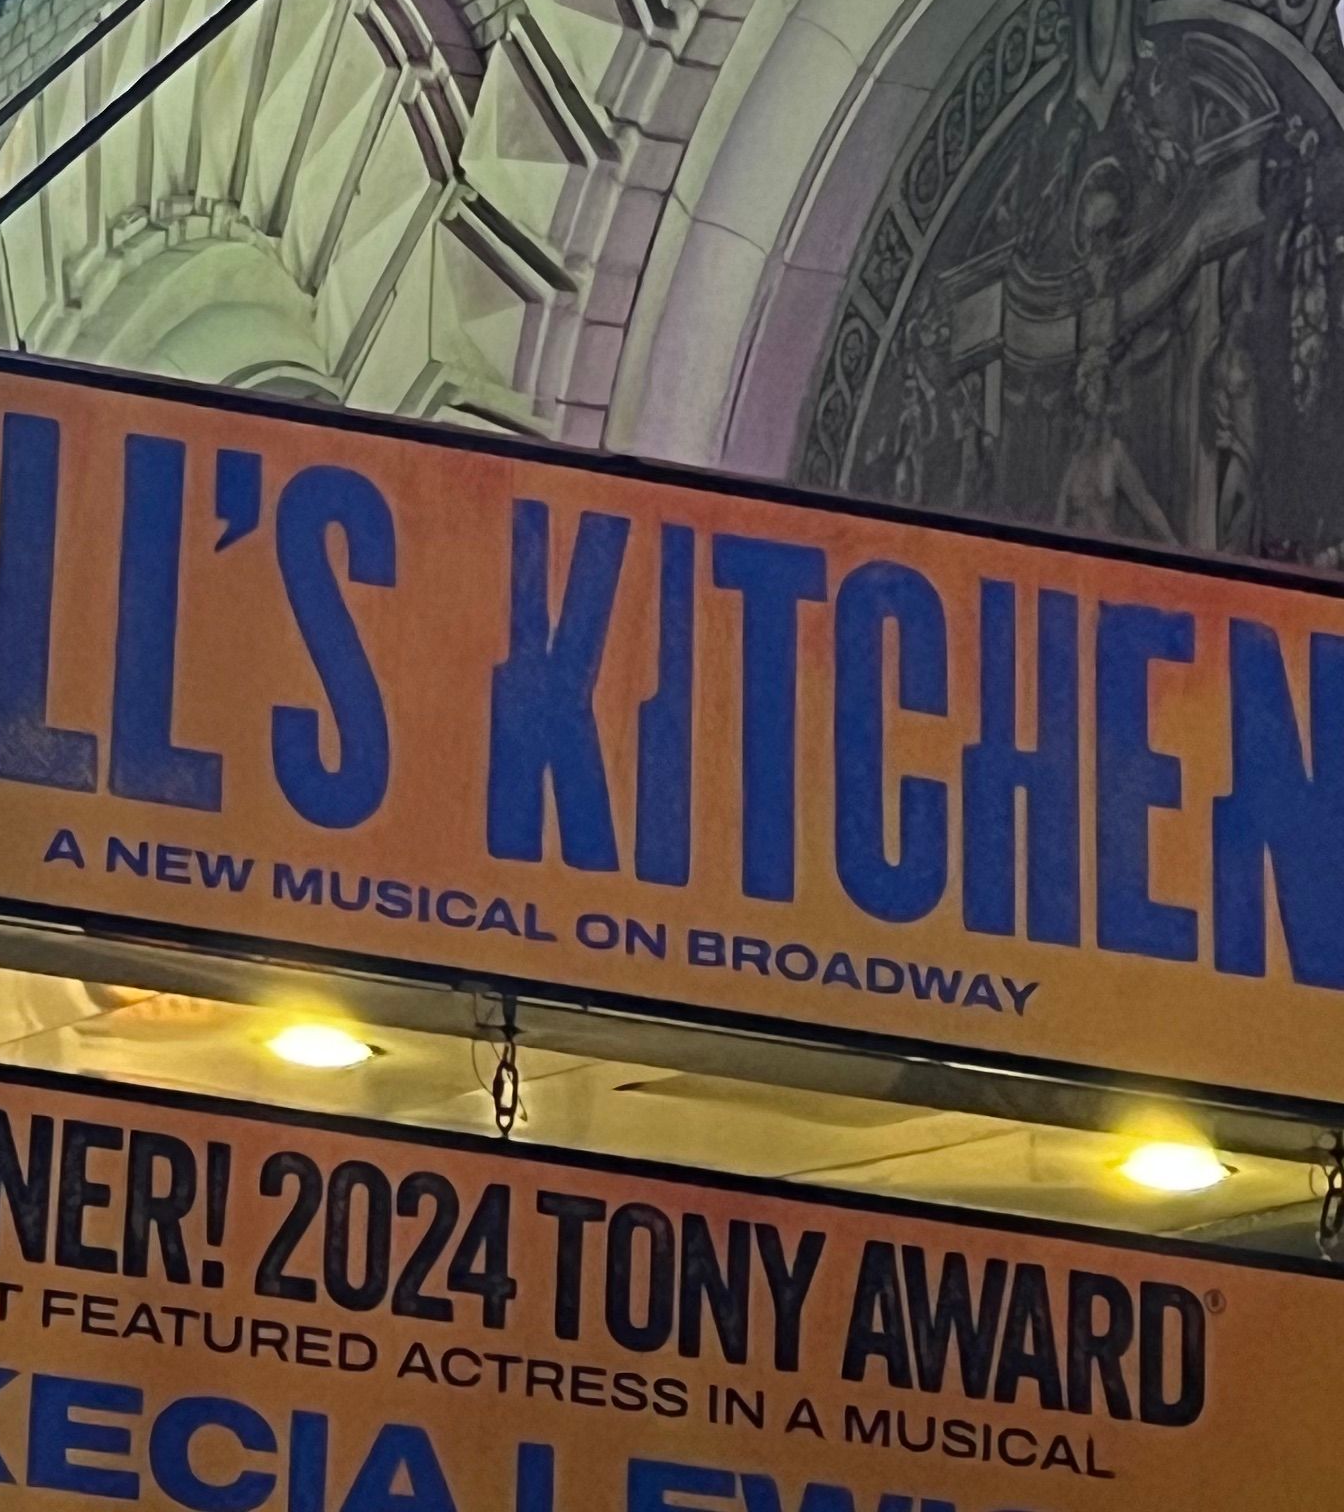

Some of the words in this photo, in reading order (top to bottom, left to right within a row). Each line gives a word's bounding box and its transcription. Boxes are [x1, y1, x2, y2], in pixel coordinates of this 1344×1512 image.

[486, 497, 1344, 990] KITCHEN
[43, 828, 85, 869] A
[106, 836, 255, 892] NEW
[272, 862, 558, 942] MUSICAL
[575, 913, 666, 959] ON
[688, 929, 1040, 1016] BROADWAY
[254, 1151, 518, 1329] 2024
[537, 1190, 826, 1372] TONY
[41, 1289, 379, 1372] FEATURED
[397, 1342, 688, 1418] ACTRESS
[709, 1384, 765, 1430] IN
[785, 1398, 826, 1440] A
[844, 1404, 1116, 1480] MUSICAL
